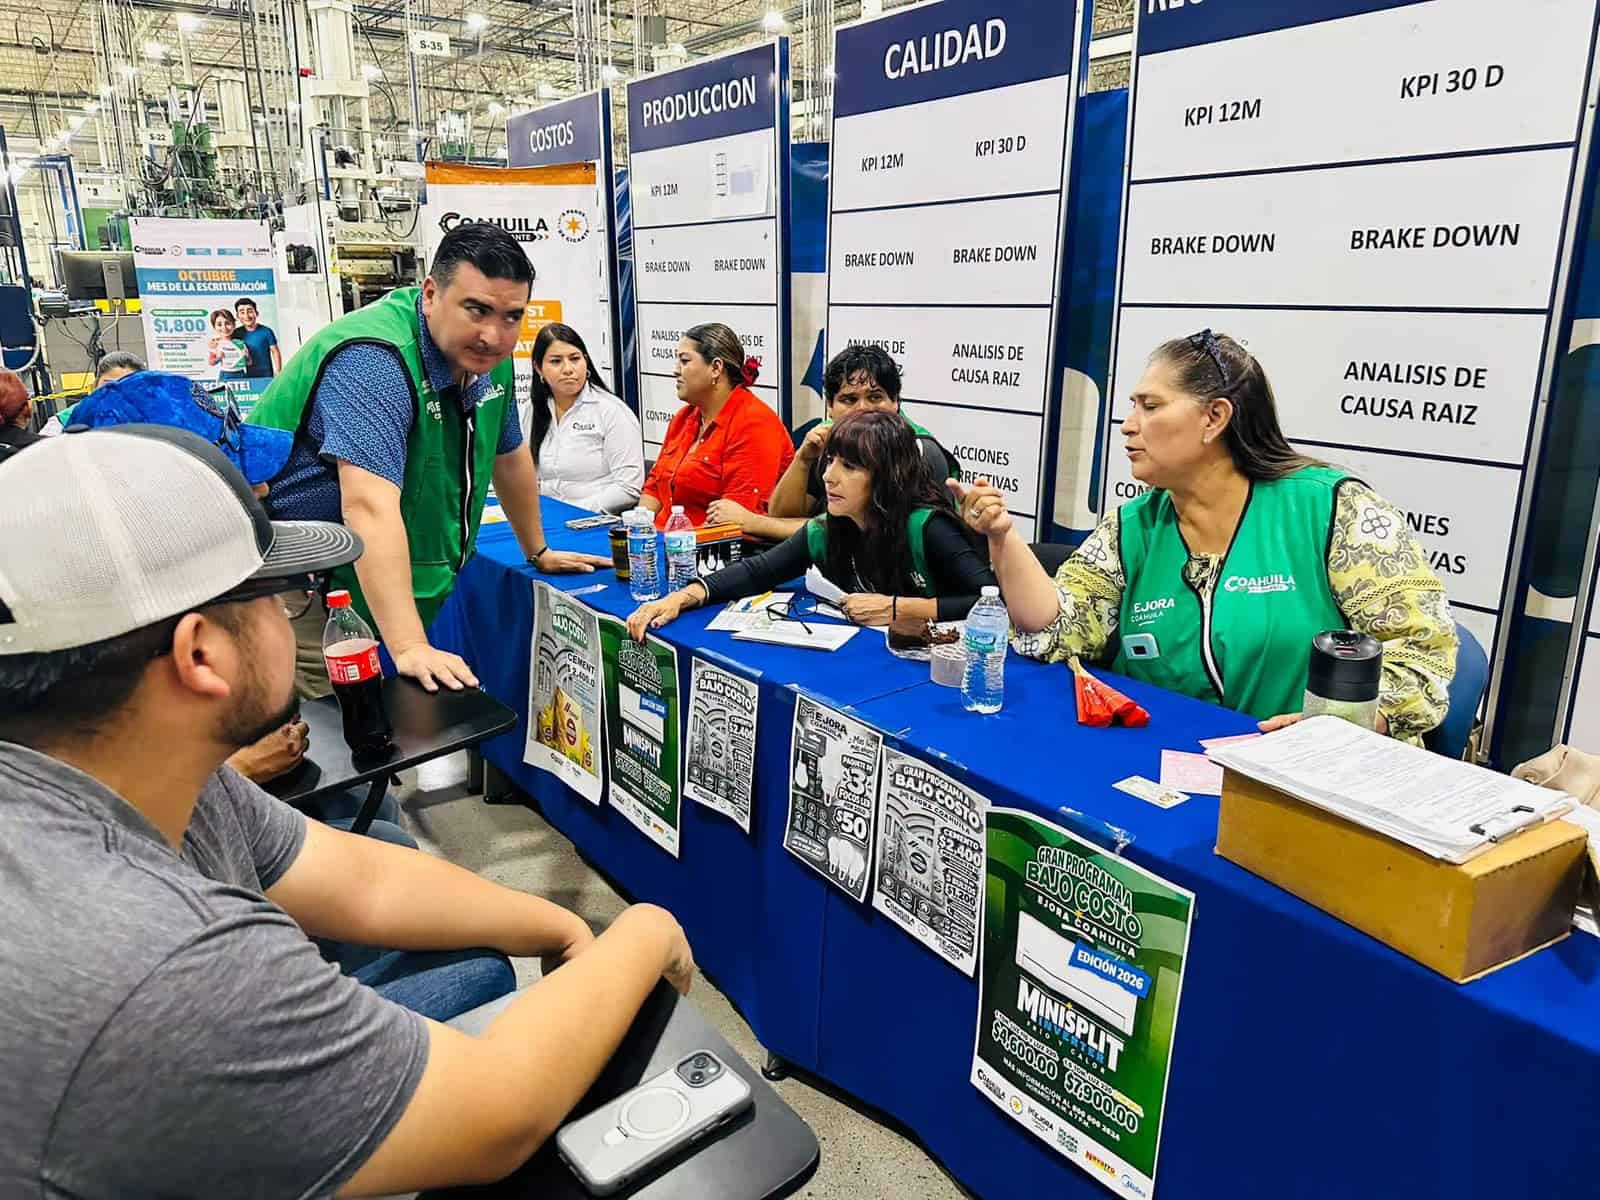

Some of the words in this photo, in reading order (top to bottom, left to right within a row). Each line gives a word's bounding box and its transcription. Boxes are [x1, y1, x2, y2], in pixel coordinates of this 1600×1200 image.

[419, 39, 443, 52] S-35
[884, 18, 1007, 80] CALIDAD
[1400, 73, 1439, 99] KPI
[1446, 68, 1478, 93] 30
[1485, 64, 1504, 88] D
[643, 76, 756, 127] PRODUCCION
[1184, 107, 1213, 127] KPI
[1218, 99, 1262, 123] 12M
[530, 121, 574, 152] COSTOS
[975, 140, 994, 157] KPI
[998, 136, 1013, 154] 30
[1017, 136, 1026, 151] D
[861, 156, 878, 172] KPI
[880, 153, 904, 170] 12M
[650, 184, 662, 197] KPI
[663, 183, 679, 196] 12M
[1150, 236, 1207, 256] BRAKE
[1211, 233, 1275, 254] DOWN
[1350, 227, 1426, 250] BRAKE
[1432, 223, 1520, 248] DOWN
[645, 261, 666, 273] BRAKE
[667, 261, 690, 272] DOWN
[714, 258, 738, 272] BRAKE
[740, 258, 766, 272] DOWN
[844, 252, 876, 267] BRAKE
[879, 251, 914, 266] DOWN
[953, 248, 991, 264] BRAKE
[994, 245, 1037, 262] DOWN
[147, 282, 168, 291] MES
[169, 282, 183, 291] DE
[184, 282, 196, 291] LA
[197, 281, 268, 291] ESCRITURACIÓN
[178, 270, 237, 282] OCTUBRE
[154, 319, 206, 334] $1,800
[651, 329, 680, 341] ANALISIS
[651, 347, 674, 359] CAUSA
[754, 335, 764, 347] DE
[892, 340, 905, 354] DE
[952, 343, 1005, 361] ANALISIS
[1007, 346, 1024, 361] DE
[951, 368, 989, 385] CAUSA
[992, 370, 1021, 387] RAIZ
[1344, 361, 1447, 387] ANALISIS
[1454, 366, 1487, 389] DE
[1340, 395, 1414, 420] CAUSA
[1421, 401, 1478, 426] RAIZ
[953, 445, 1009, 466] ACCIONES
[1224, 574, 1296, 593] COAHUILA
[699, 678, 724, 694] BAJO
[725, 686, 752, 711] COSTO
[846, 769, 867, 795] 3
[903, 766, 925, 780] GRAN
[925, 773, 964, 801] PROGRAMA
[895, 773, 934, 798] BAJO
[935, 789, 980, 829] COSTO
[834, 809, 867, 840] $50
[938, 835, 982, 867] $2,400
[1038, 846, 1065, 868] GRAN
[1065, 852, 1122, 903] PROGRAMA
[1121, 888, 1133, 911] A
[1025, 861, 1074, 902] BAJO
[1075, 883, 1142, 940] COSTO
[1074, 917, 1137, 958] COAHUILA
[1077, 950, 1116, 978] EDICIÓN
[1116, 965, 1144, 990] 2026
[1017, 979, 1124, 1072] MINISPLIT
[992, 1020, 1058, 1080] $4,600.00
[1037, 1016, 1105, 1064] INVERTER
[1070, 1048, 1105, 1074] CALOR
[1064, 1070, 1138, 1133] $7,900.00
